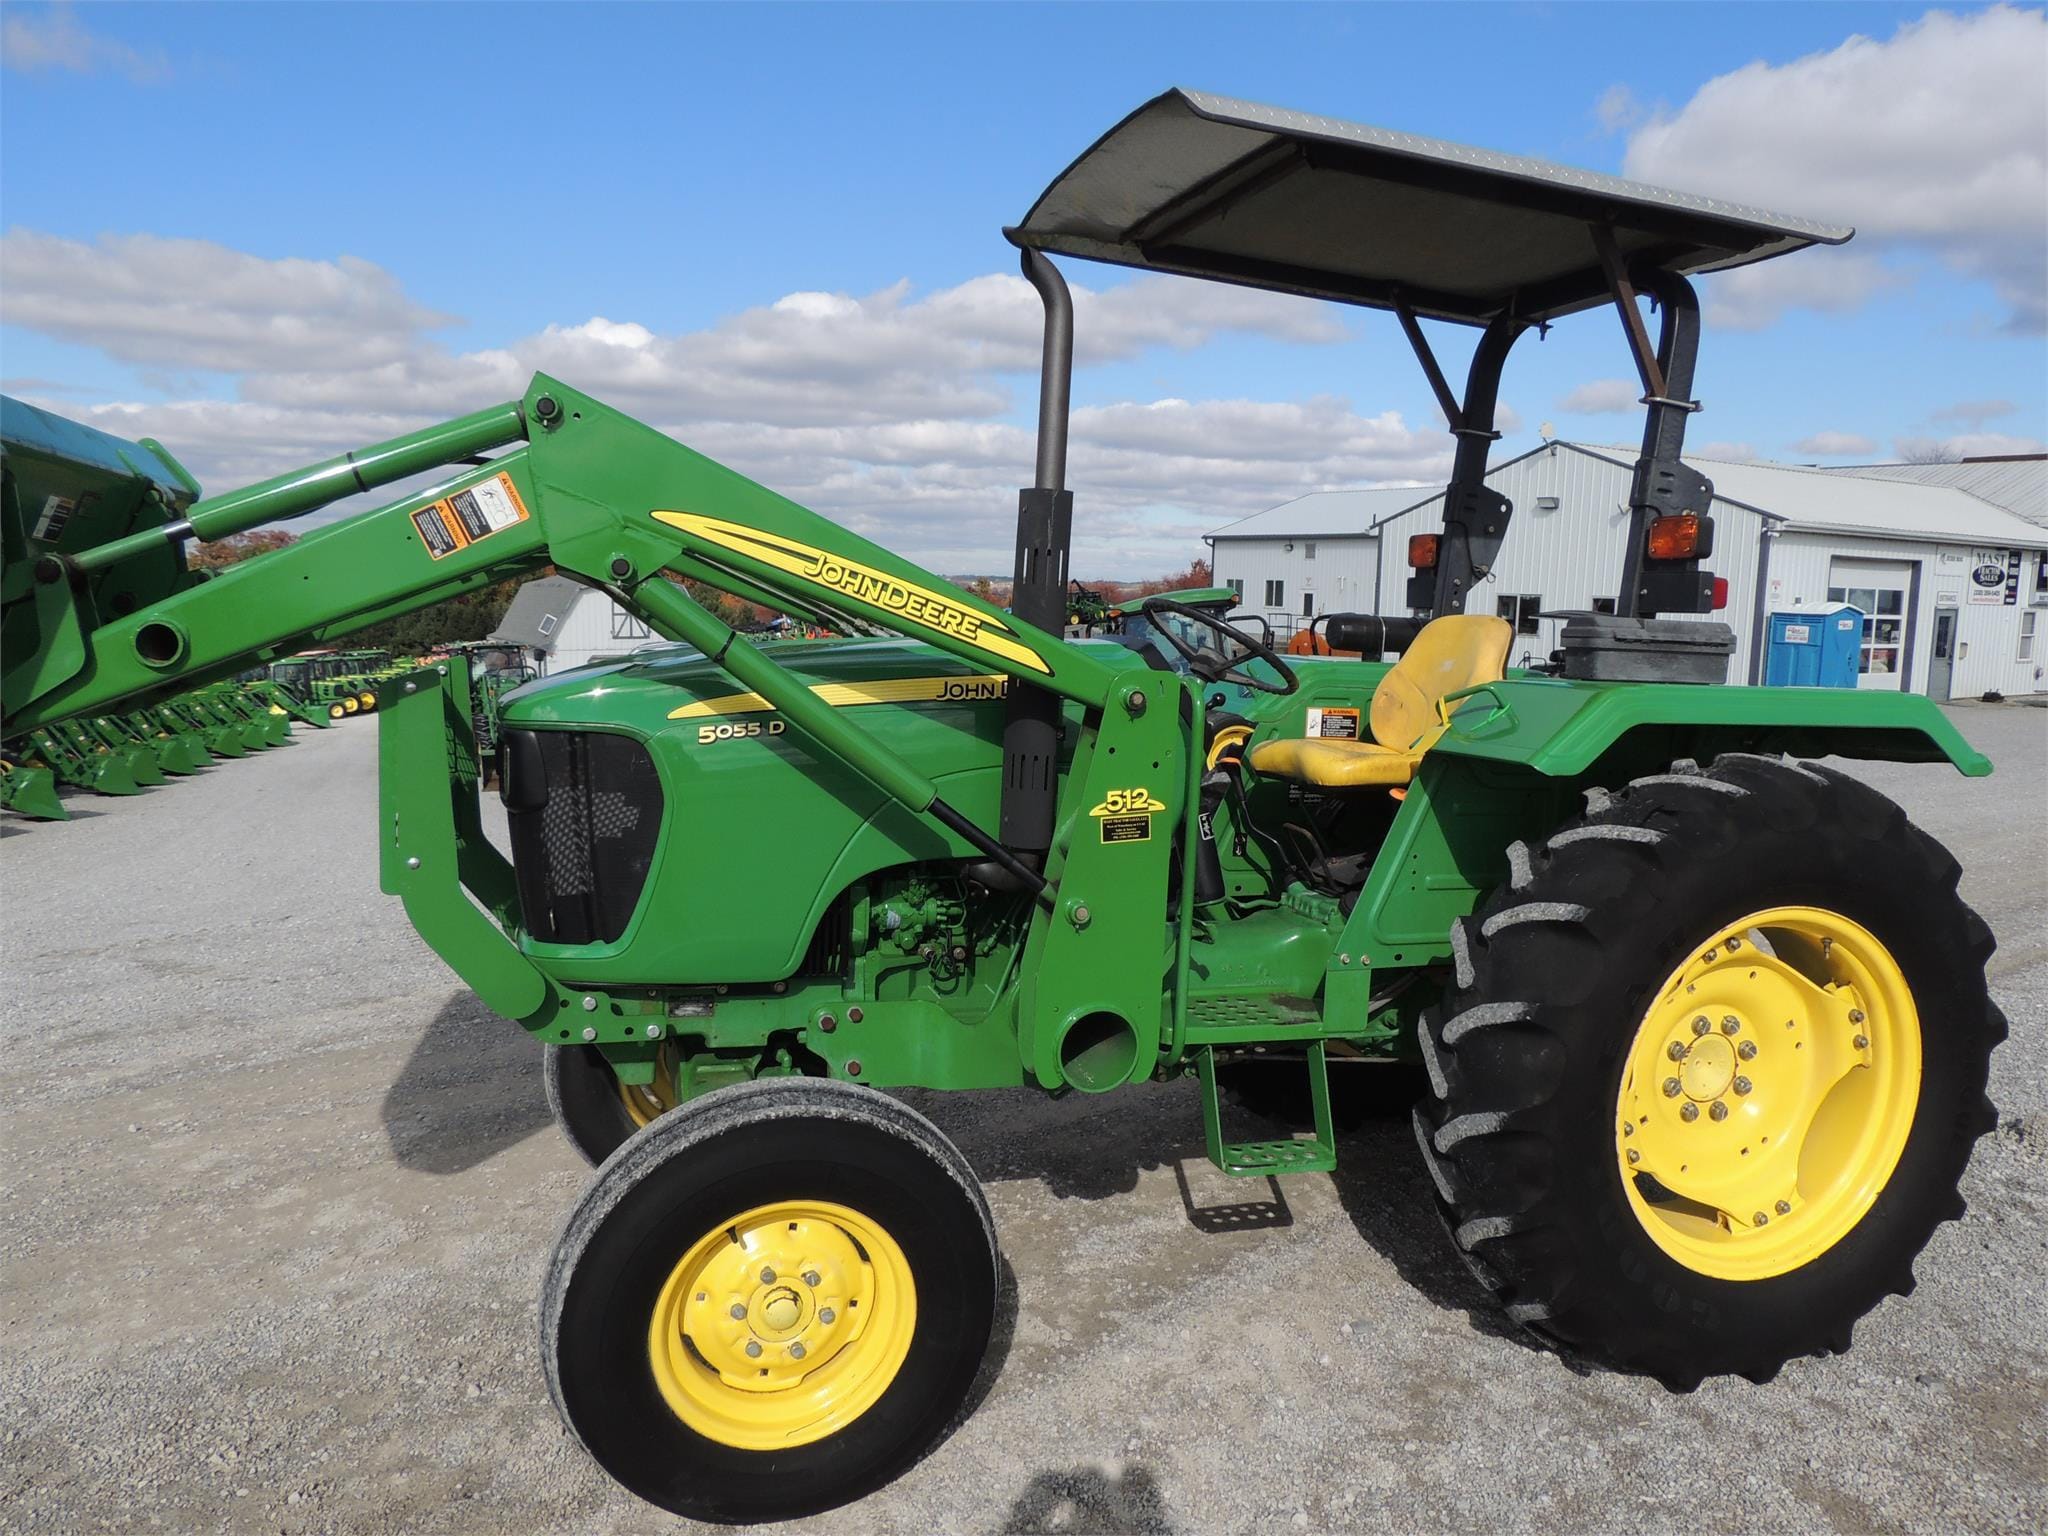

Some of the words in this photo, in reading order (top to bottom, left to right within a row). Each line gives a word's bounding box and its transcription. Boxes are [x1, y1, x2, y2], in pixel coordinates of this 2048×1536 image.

[935, 680, 995, 699] JOHN
[697, 721, 762, 745] 5055
[768, 719, 786, 736] D
[1106, 788, 1149, 812] 512
